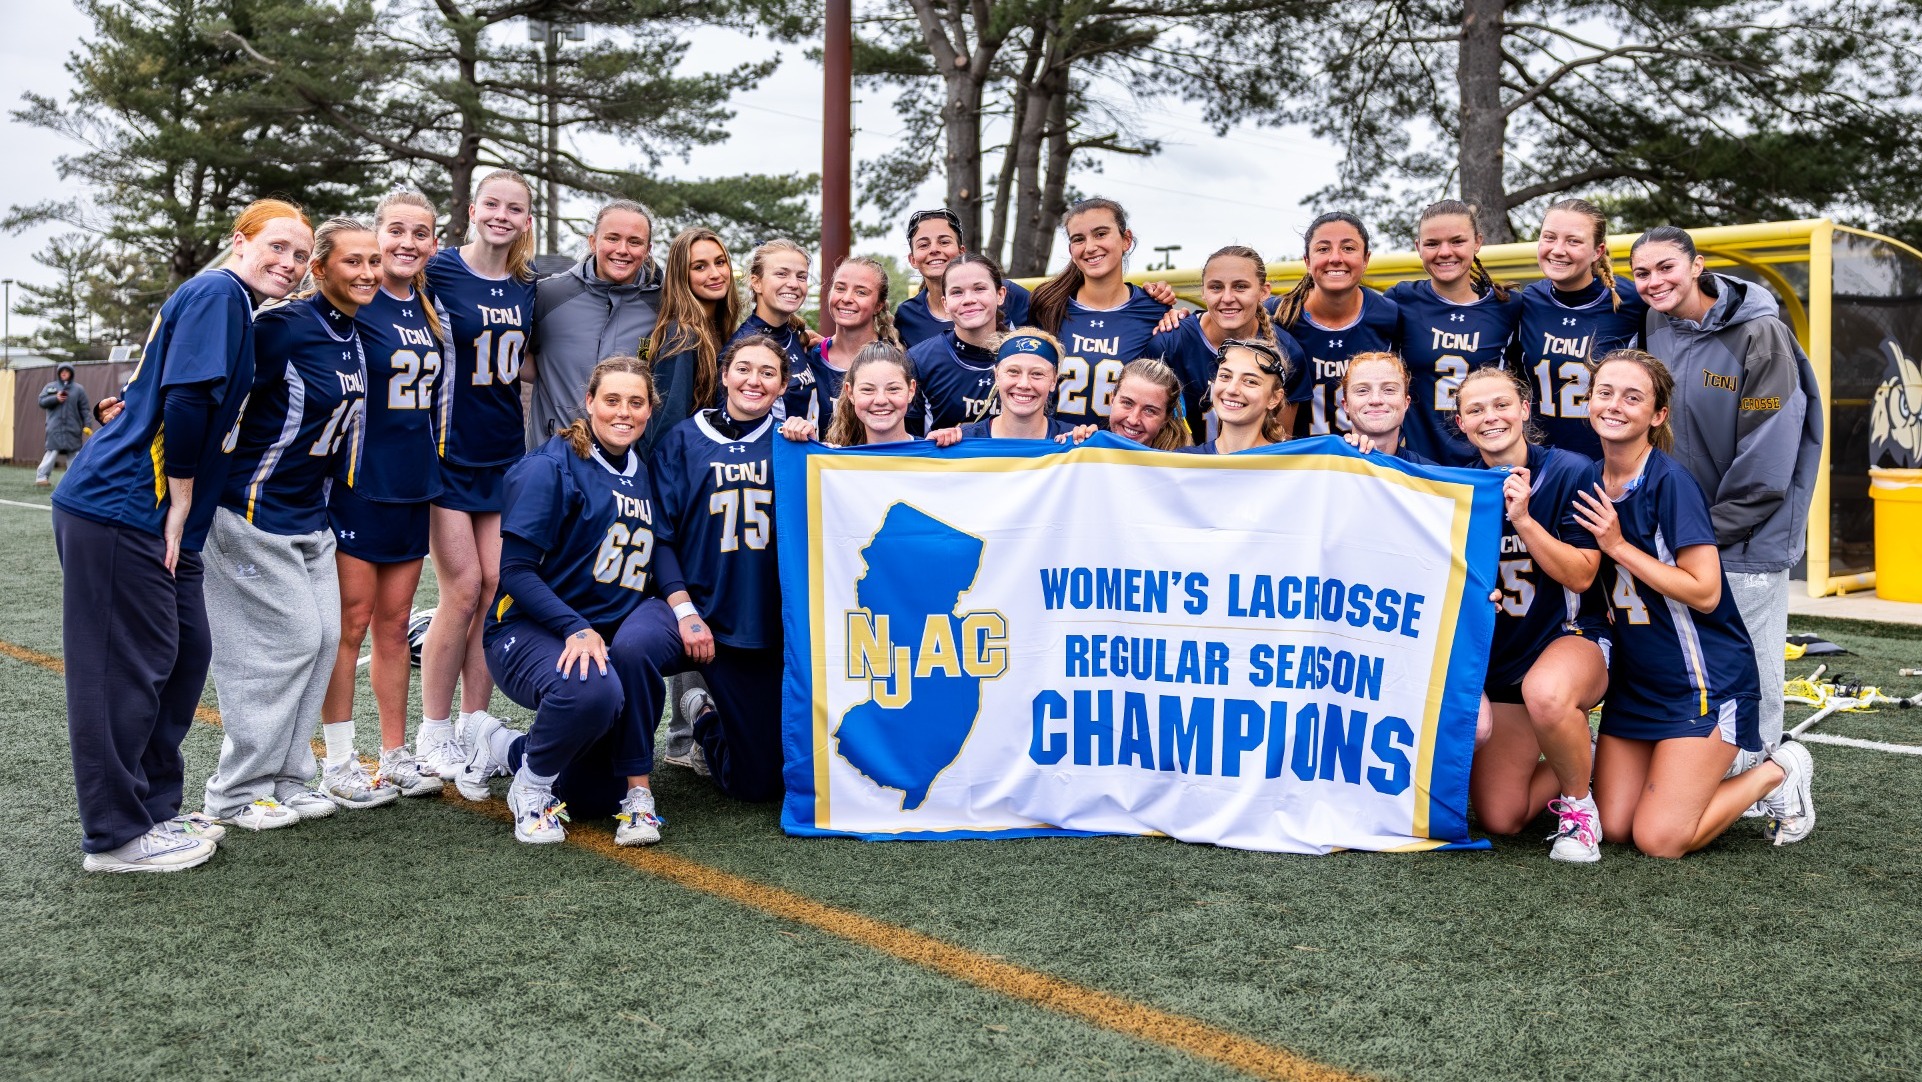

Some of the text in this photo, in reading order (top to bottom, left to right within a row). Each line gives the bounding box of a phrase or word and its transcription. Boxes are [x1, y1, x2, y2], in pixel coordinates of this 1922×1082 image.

[392, 324, 434, 348] TCNJ
[477, 304, 522, 327] TCNJ
[1431, 327, 1480, 353] TCNJ
[471, 329, 526, 386] 10
[1072, 334, 1120, 356] TCNJ
[1312, 357, 1351, 381] TCN
[1543, 332, 1590, 359] TCNJ
[335, 368, 365, 396] TCNJ
[387, 349, 442, 410] 22
[1056, 356, 1125, 418] 26
[1434, 354, 1470, 411] 2
[1533, 358, 1593, 419] 12
[1702, 368, 1739, 393] TCNJ
[1739, 397, 1781, 411] CROSSE
[709, 459, 768, 488] TCNJ
[612, 489, 652, 526] TCNJ
[709, 488, 773, 553] 75
[592, 521, 654, 593] 62
[1500, 535, 1528, 554] CN
[1040, 567, 1425, 639] WOMEN'S LACROSSE
[1498, 558, 1536, 618] 5
[1612, 563, 1651, 625] 4
[845, 609, 1010, 710] NJAC
[1065, 634, 1385, 702] REGULAR SEASON
[1028, 689, 1414, 796] CHAMPIONS
